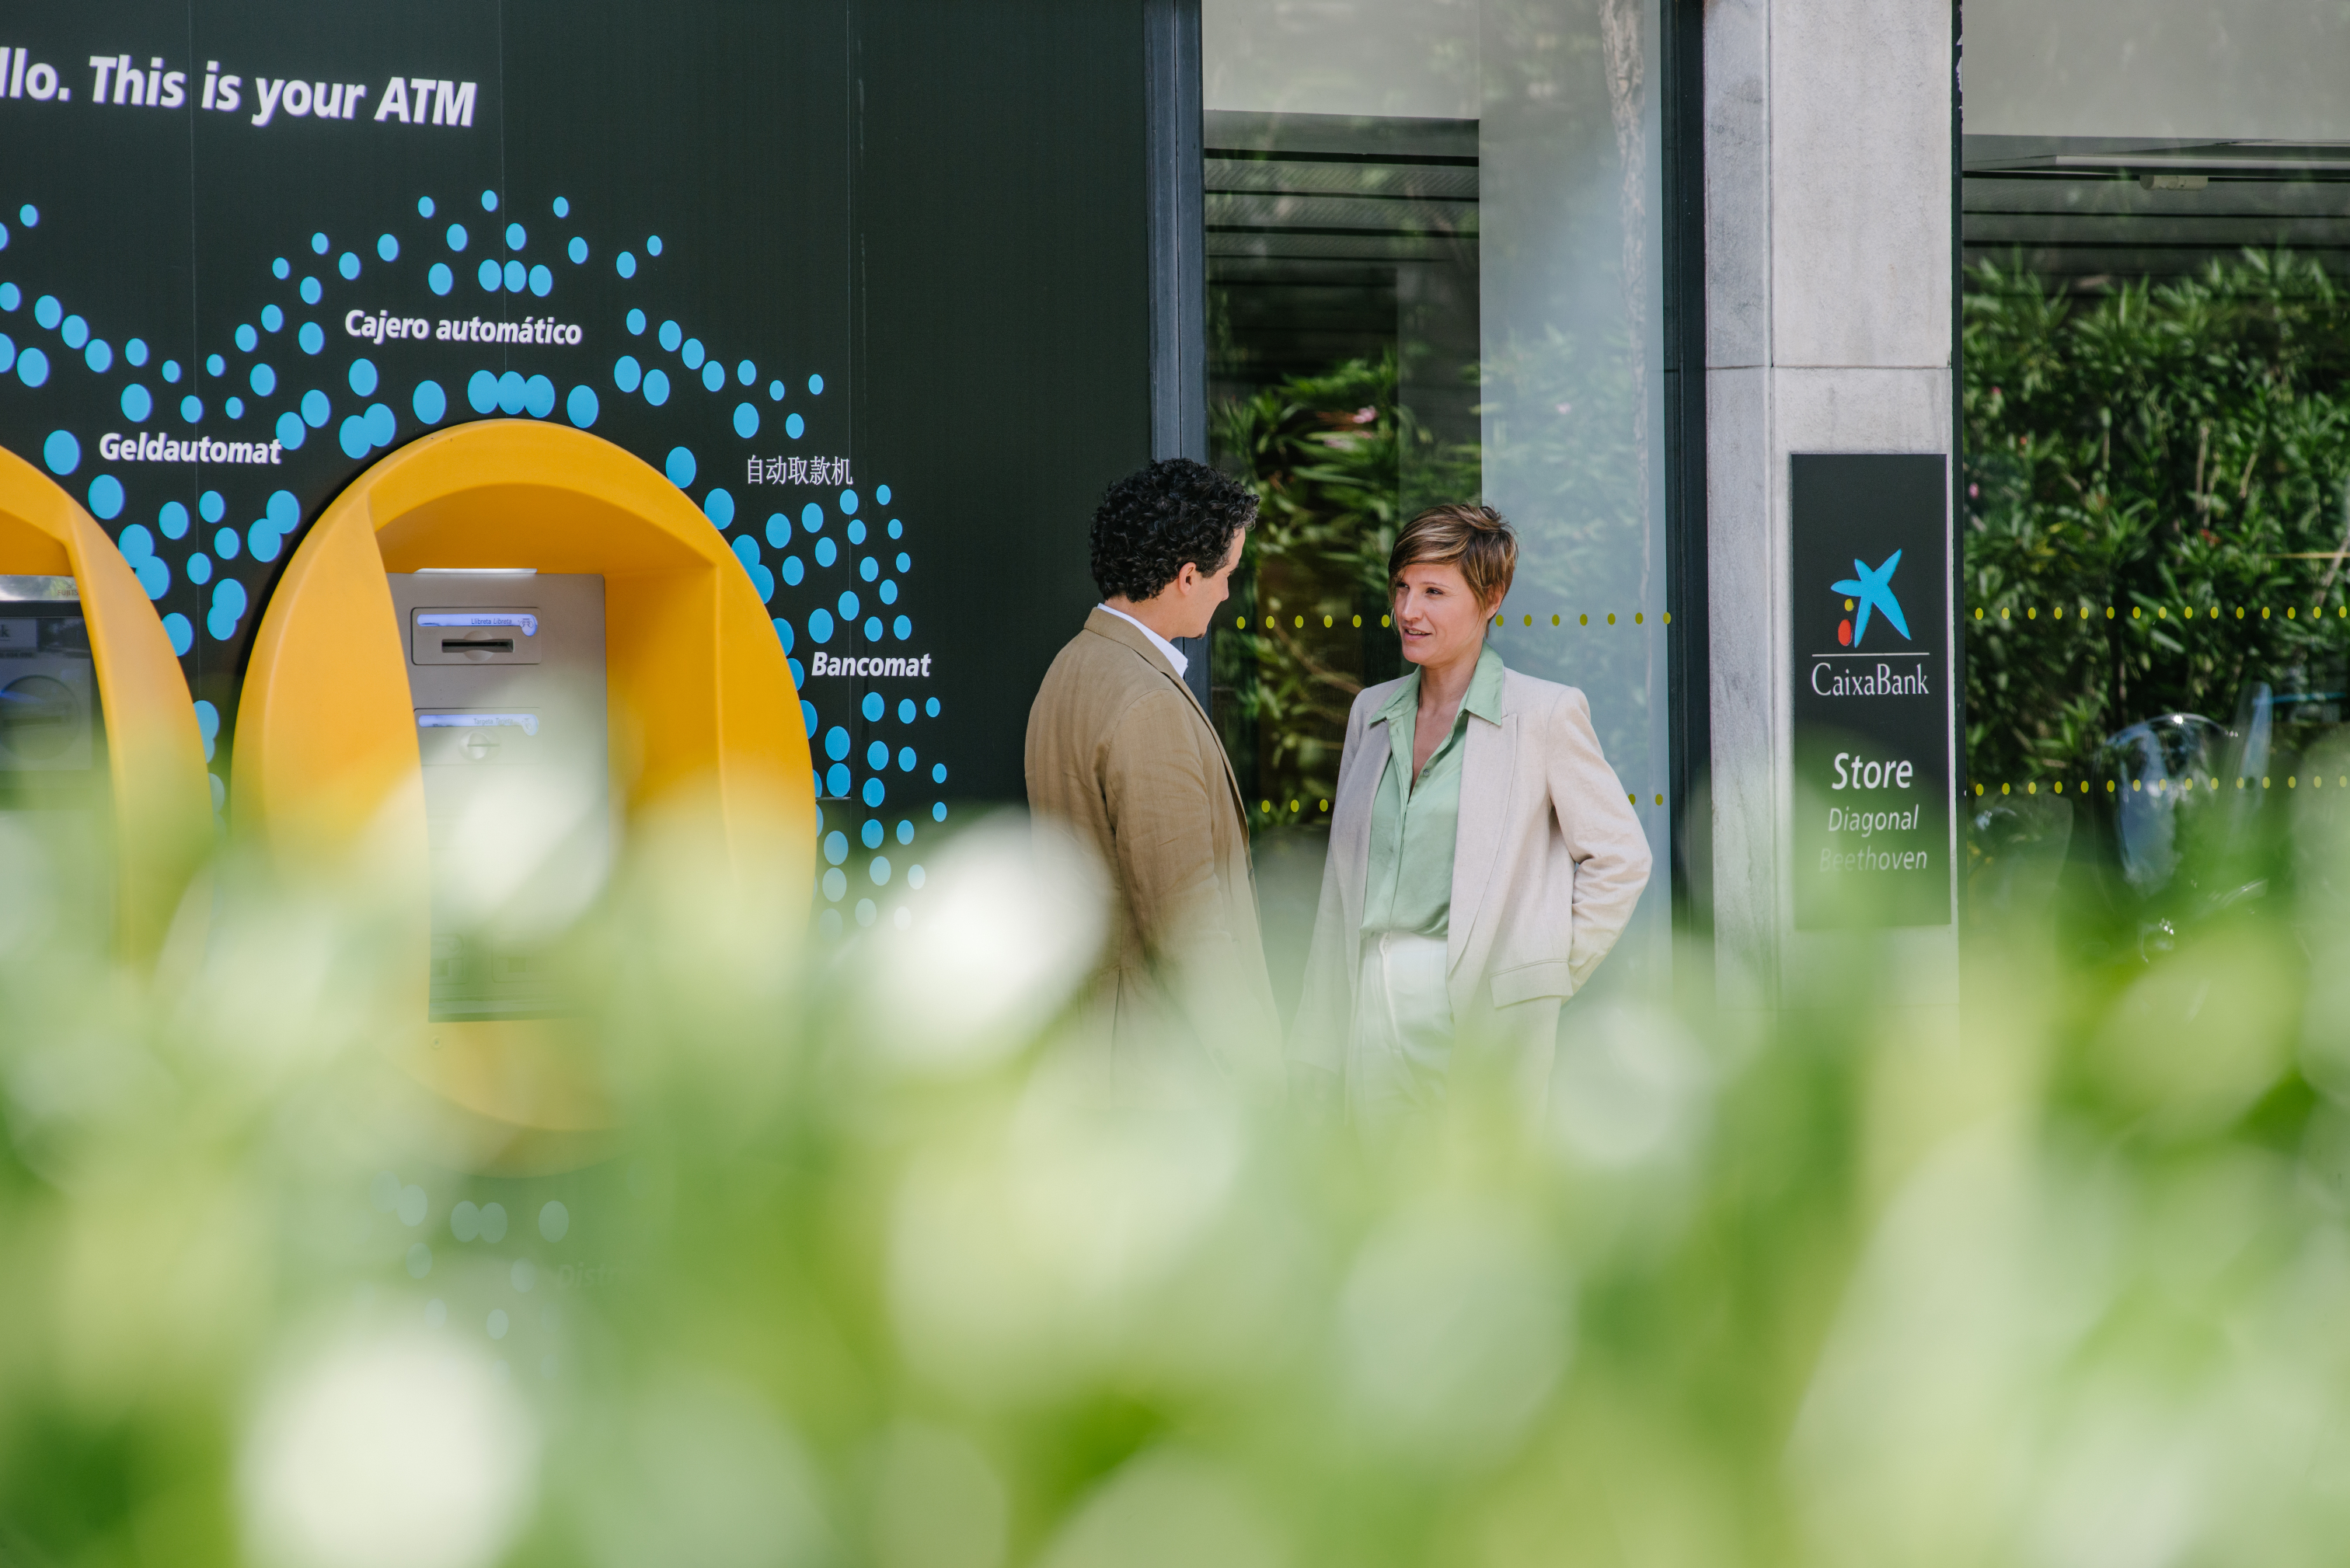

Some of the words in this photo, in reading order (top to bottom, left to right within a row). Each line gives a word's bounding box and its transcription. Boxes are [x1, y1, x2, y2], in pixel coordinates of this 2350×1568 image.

[89, 54, 186, 108] This
[201, 60, 241, 111] is
[251, 77, 366, 127] your
[373, 76, 477, 127] ATM
[345, 309, 430, 345] Cajero
[435, 315, 582, 345] automático
[99, 432, 282, 464] Geldautomat
[747, 455, 853, 486] 自动取款机
[57, 589, 78, 598] FUJITS
[811, 651, 932, 678] Bancomat
[1811, 662, 1930, 695] CaixaBank
[1831, 752, 1912, 789] Store
[1828, 803, 1919, 838] Diagonal
[1819, 845, 1928, 873] Beethoven
